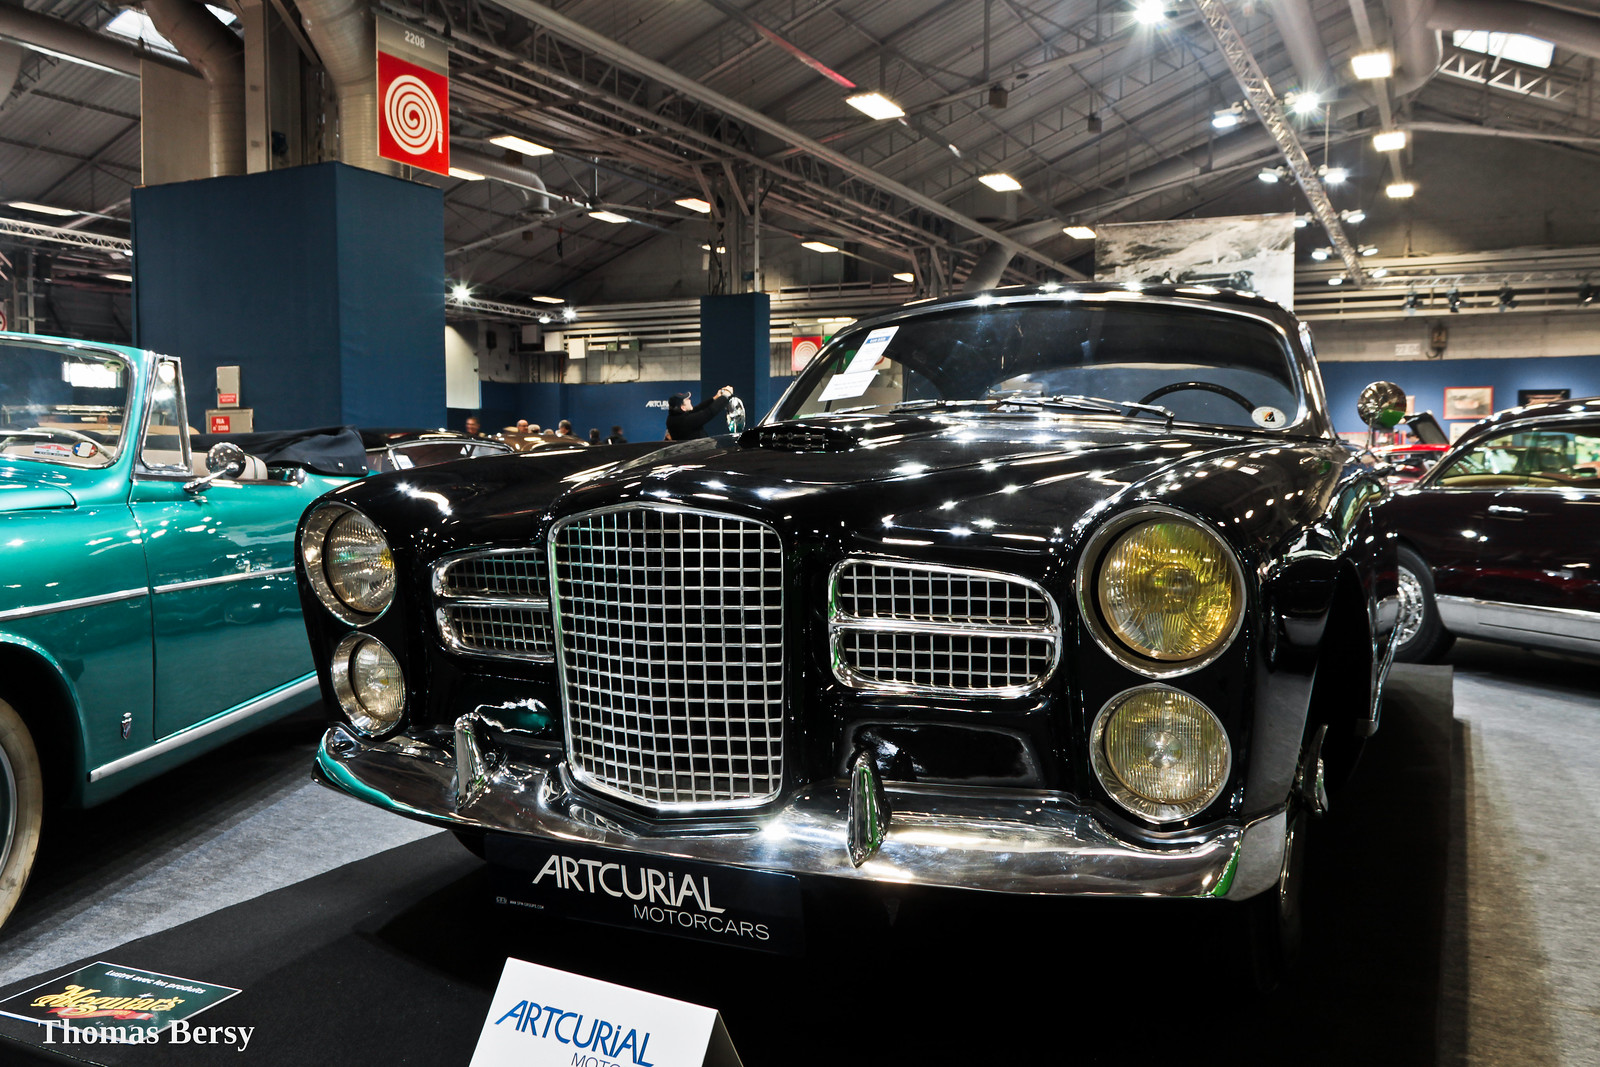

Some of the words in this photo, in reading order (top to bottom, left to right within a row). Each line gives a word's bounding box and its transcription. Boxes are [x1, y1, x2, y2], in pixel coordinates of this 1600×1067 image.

[404, 30, 425, 49] 2208
[633, 903, 770, 941] MOTORCARS
[131, 976, 155, 984] avec
[152, 979, 169, 988] les
[164, 983, 207, 995] produits
